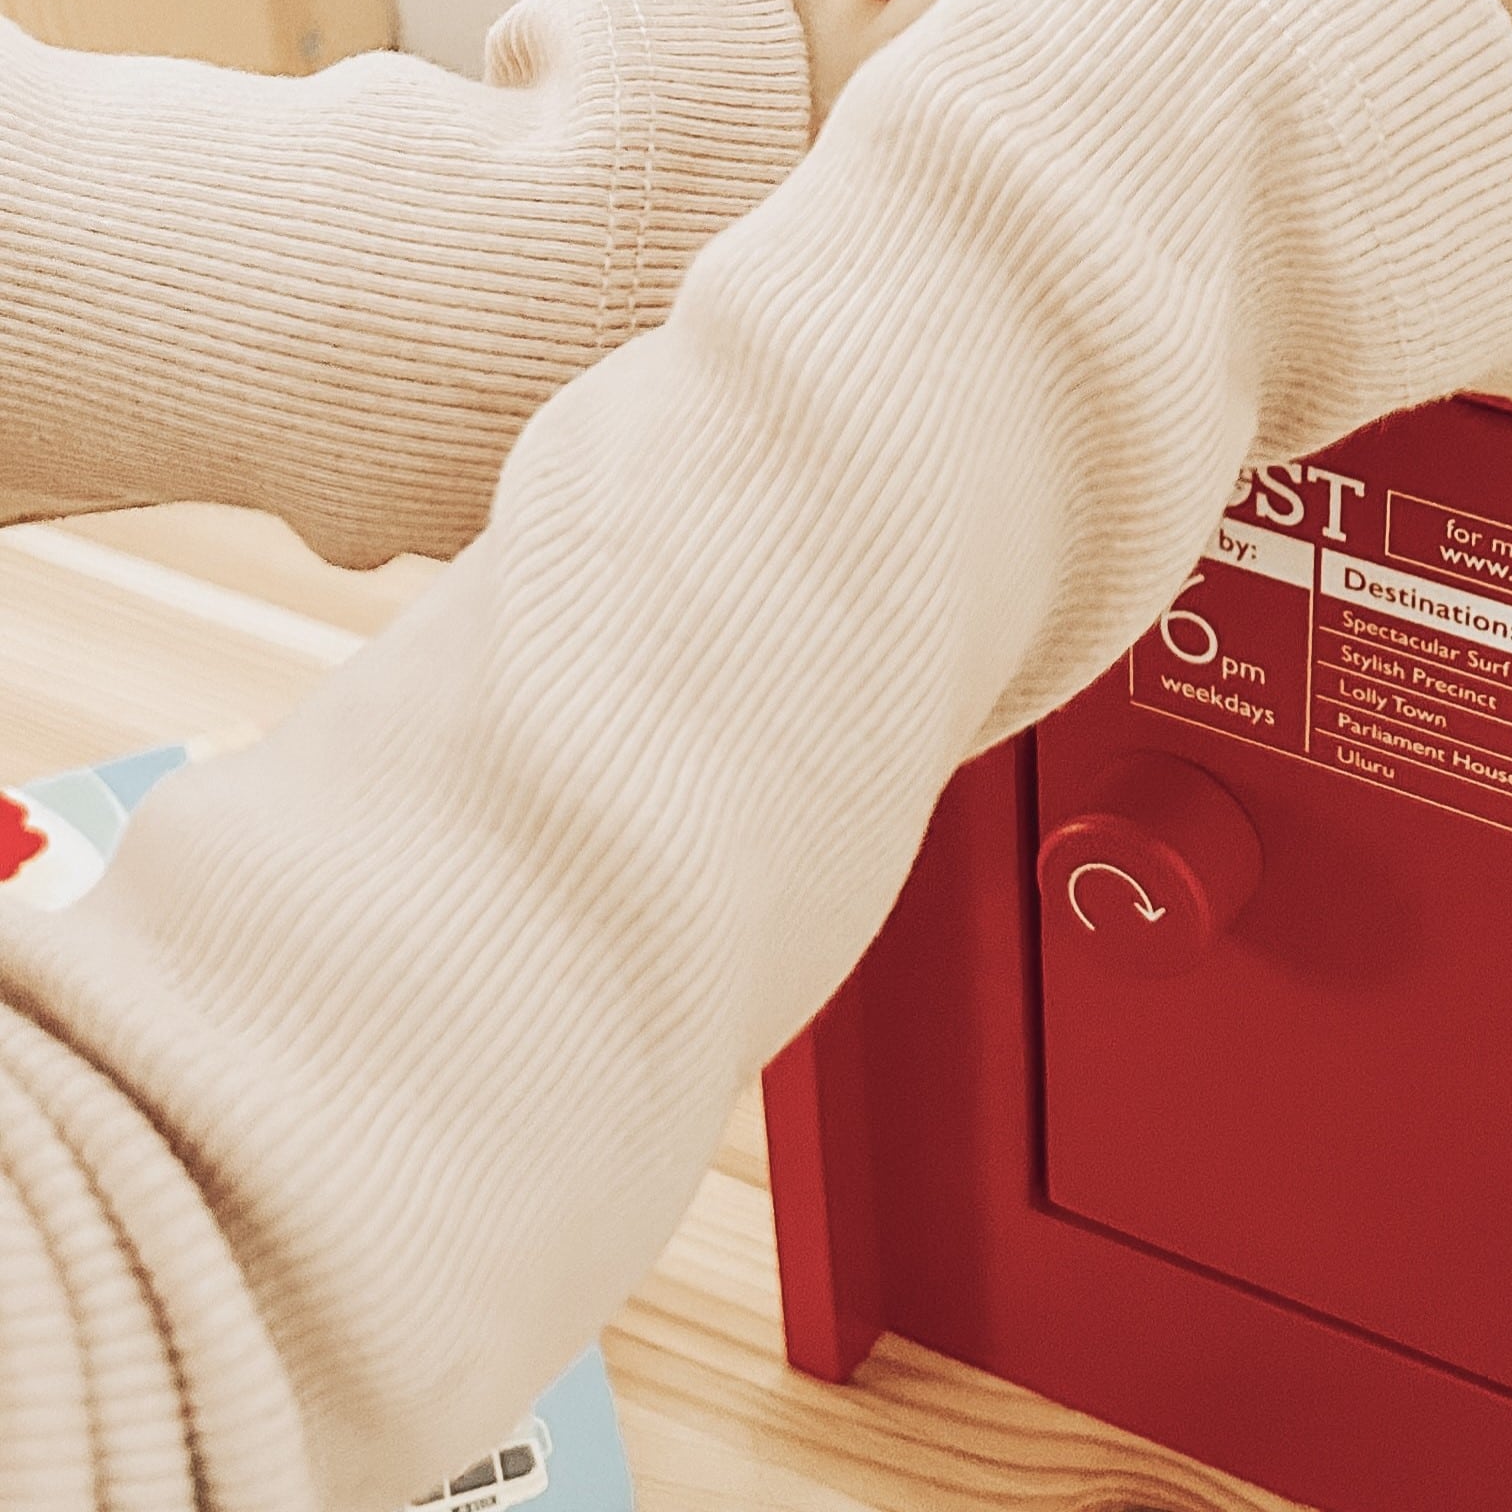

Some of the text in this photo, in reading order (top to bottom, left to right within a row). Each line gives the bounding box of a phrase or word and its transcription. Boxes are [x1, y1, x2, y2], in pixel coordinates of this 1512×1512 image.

[1218, 529, 1258, 562] by:
[1446, 519, 1483, 548] for
[1159, 573, 1267, 685] 6 pm
[1342, 610, 1511, 678] Spectacular Surf
[1161, 674, 1275, 726] weekdays
[1339, 678, 1448, 728] Lolly Town
[1340, 644, 1498, 711] Stylish Precinct
[1336, 745, 1395, 780] Uluru
[1338, 712, 1446, 763] Parliament
